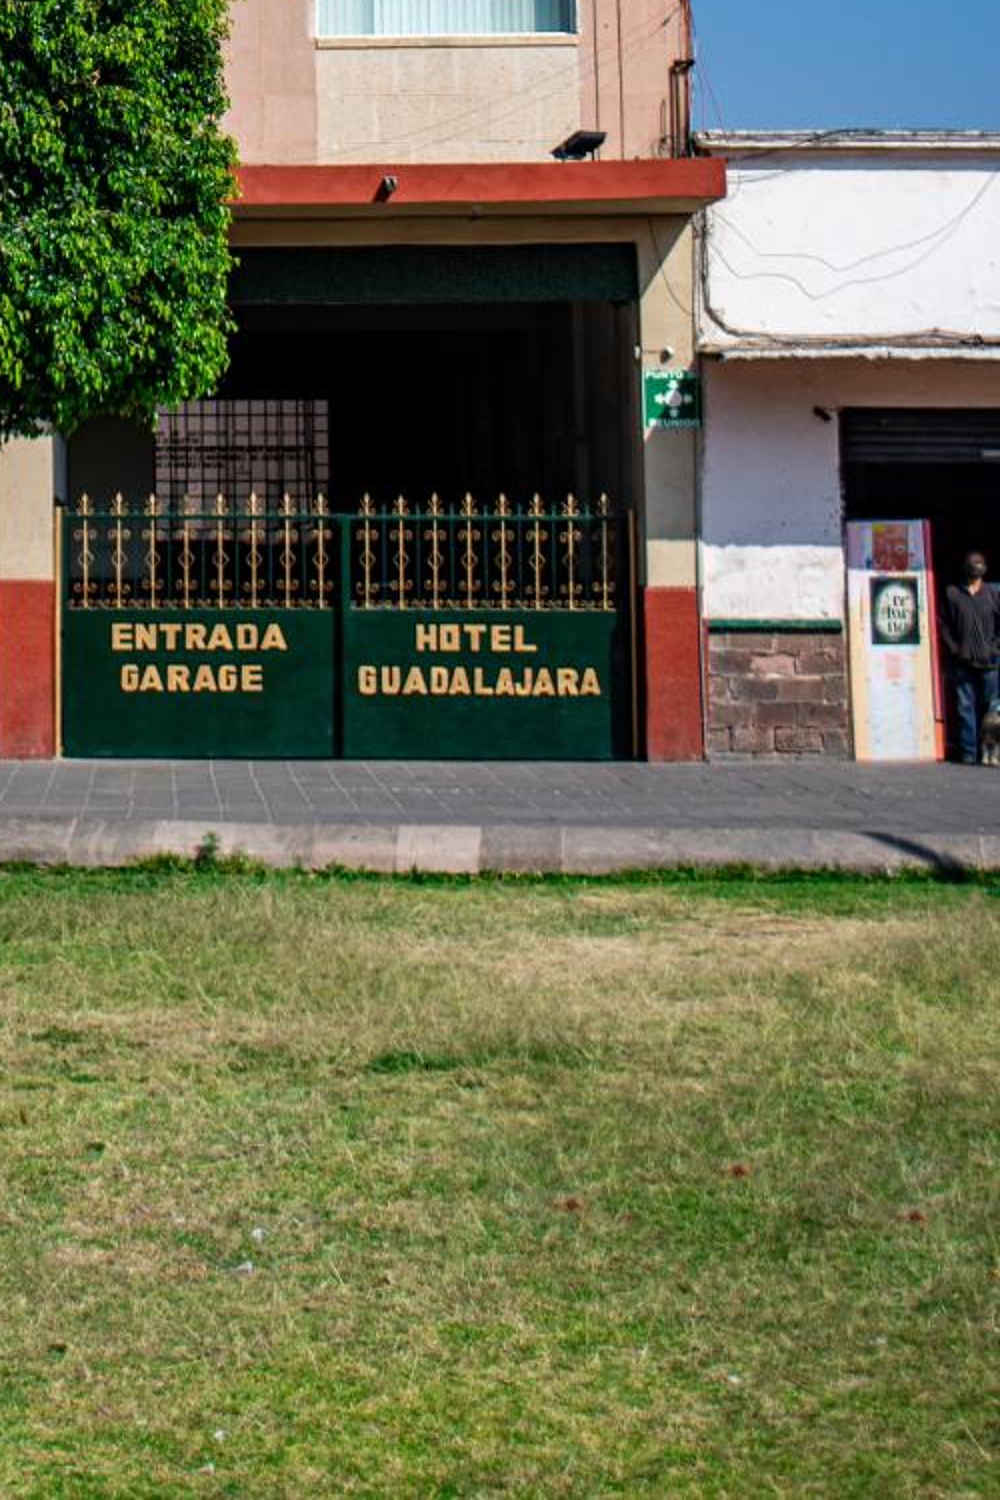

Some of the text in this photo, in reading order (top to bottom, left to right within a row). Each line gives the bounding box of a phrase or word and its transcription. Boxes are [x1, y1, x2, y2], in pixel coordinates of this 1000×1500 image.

[111, 623, 288, 650] ENTRADA
[415, 624, 537, 652] HOTEL
[120, 663, 264, 692] GARAGE
[358, 665, 601, 695] GUADALAJARA
